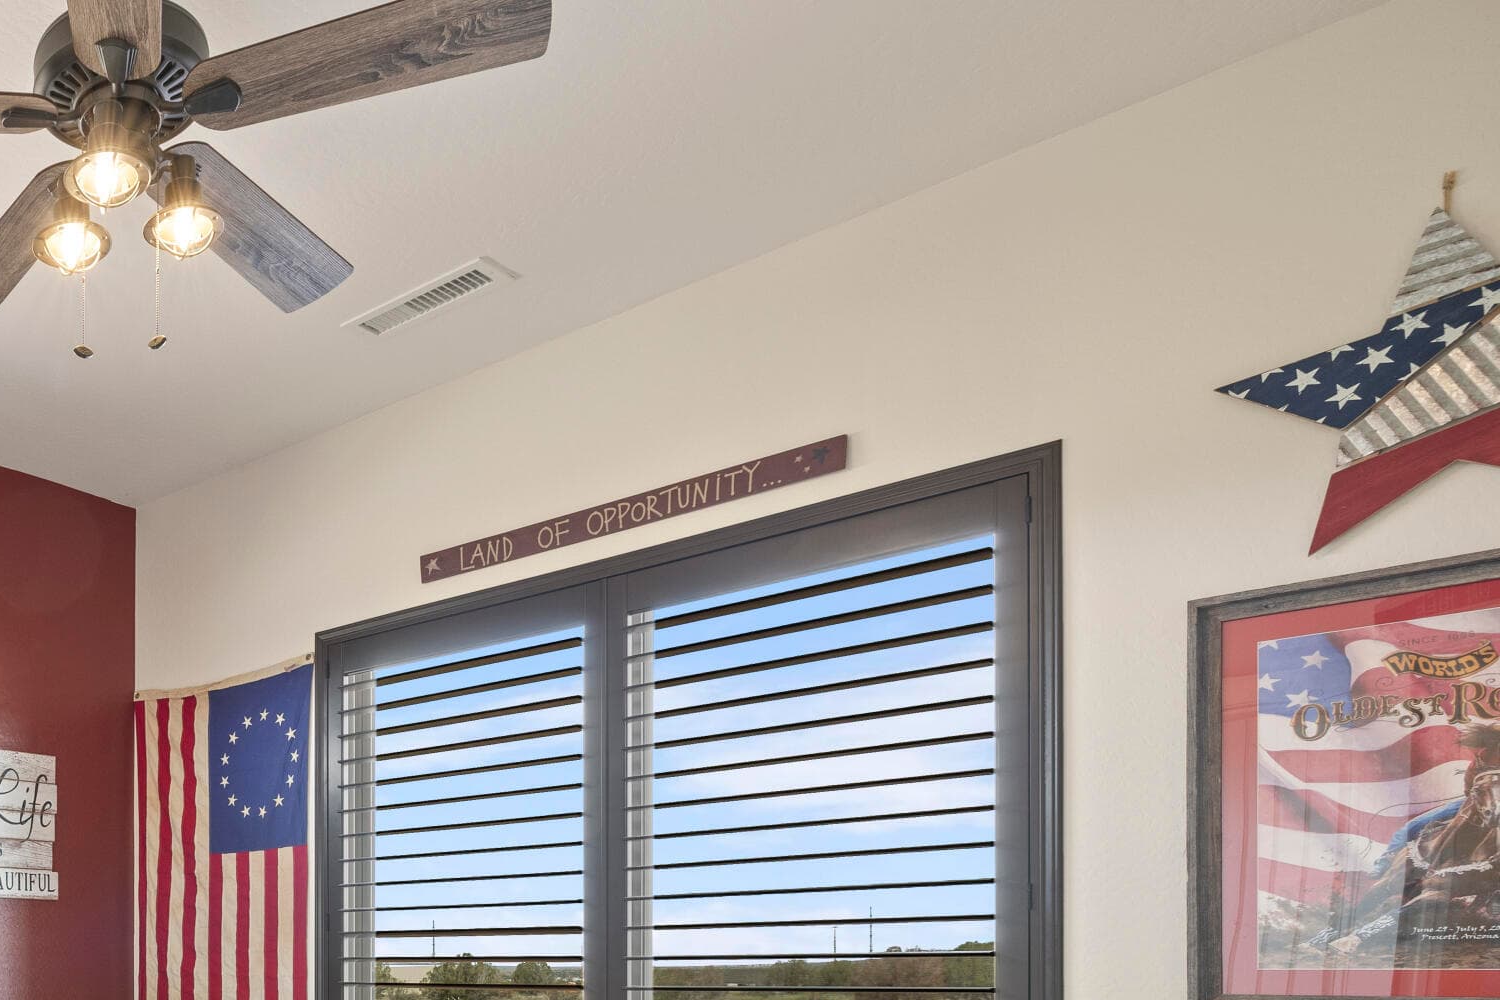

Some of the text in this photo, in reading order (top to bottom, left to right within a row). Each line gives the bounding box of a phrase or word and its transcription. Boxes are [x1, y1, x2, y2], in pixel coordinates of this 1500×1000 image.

[458, 539, 513, 571] LAND
[537, 519, 570, 549] OF
[1387, 645, 1497, 677] WORLD'S
[1290, 694, 1448, 741] OLDEST
